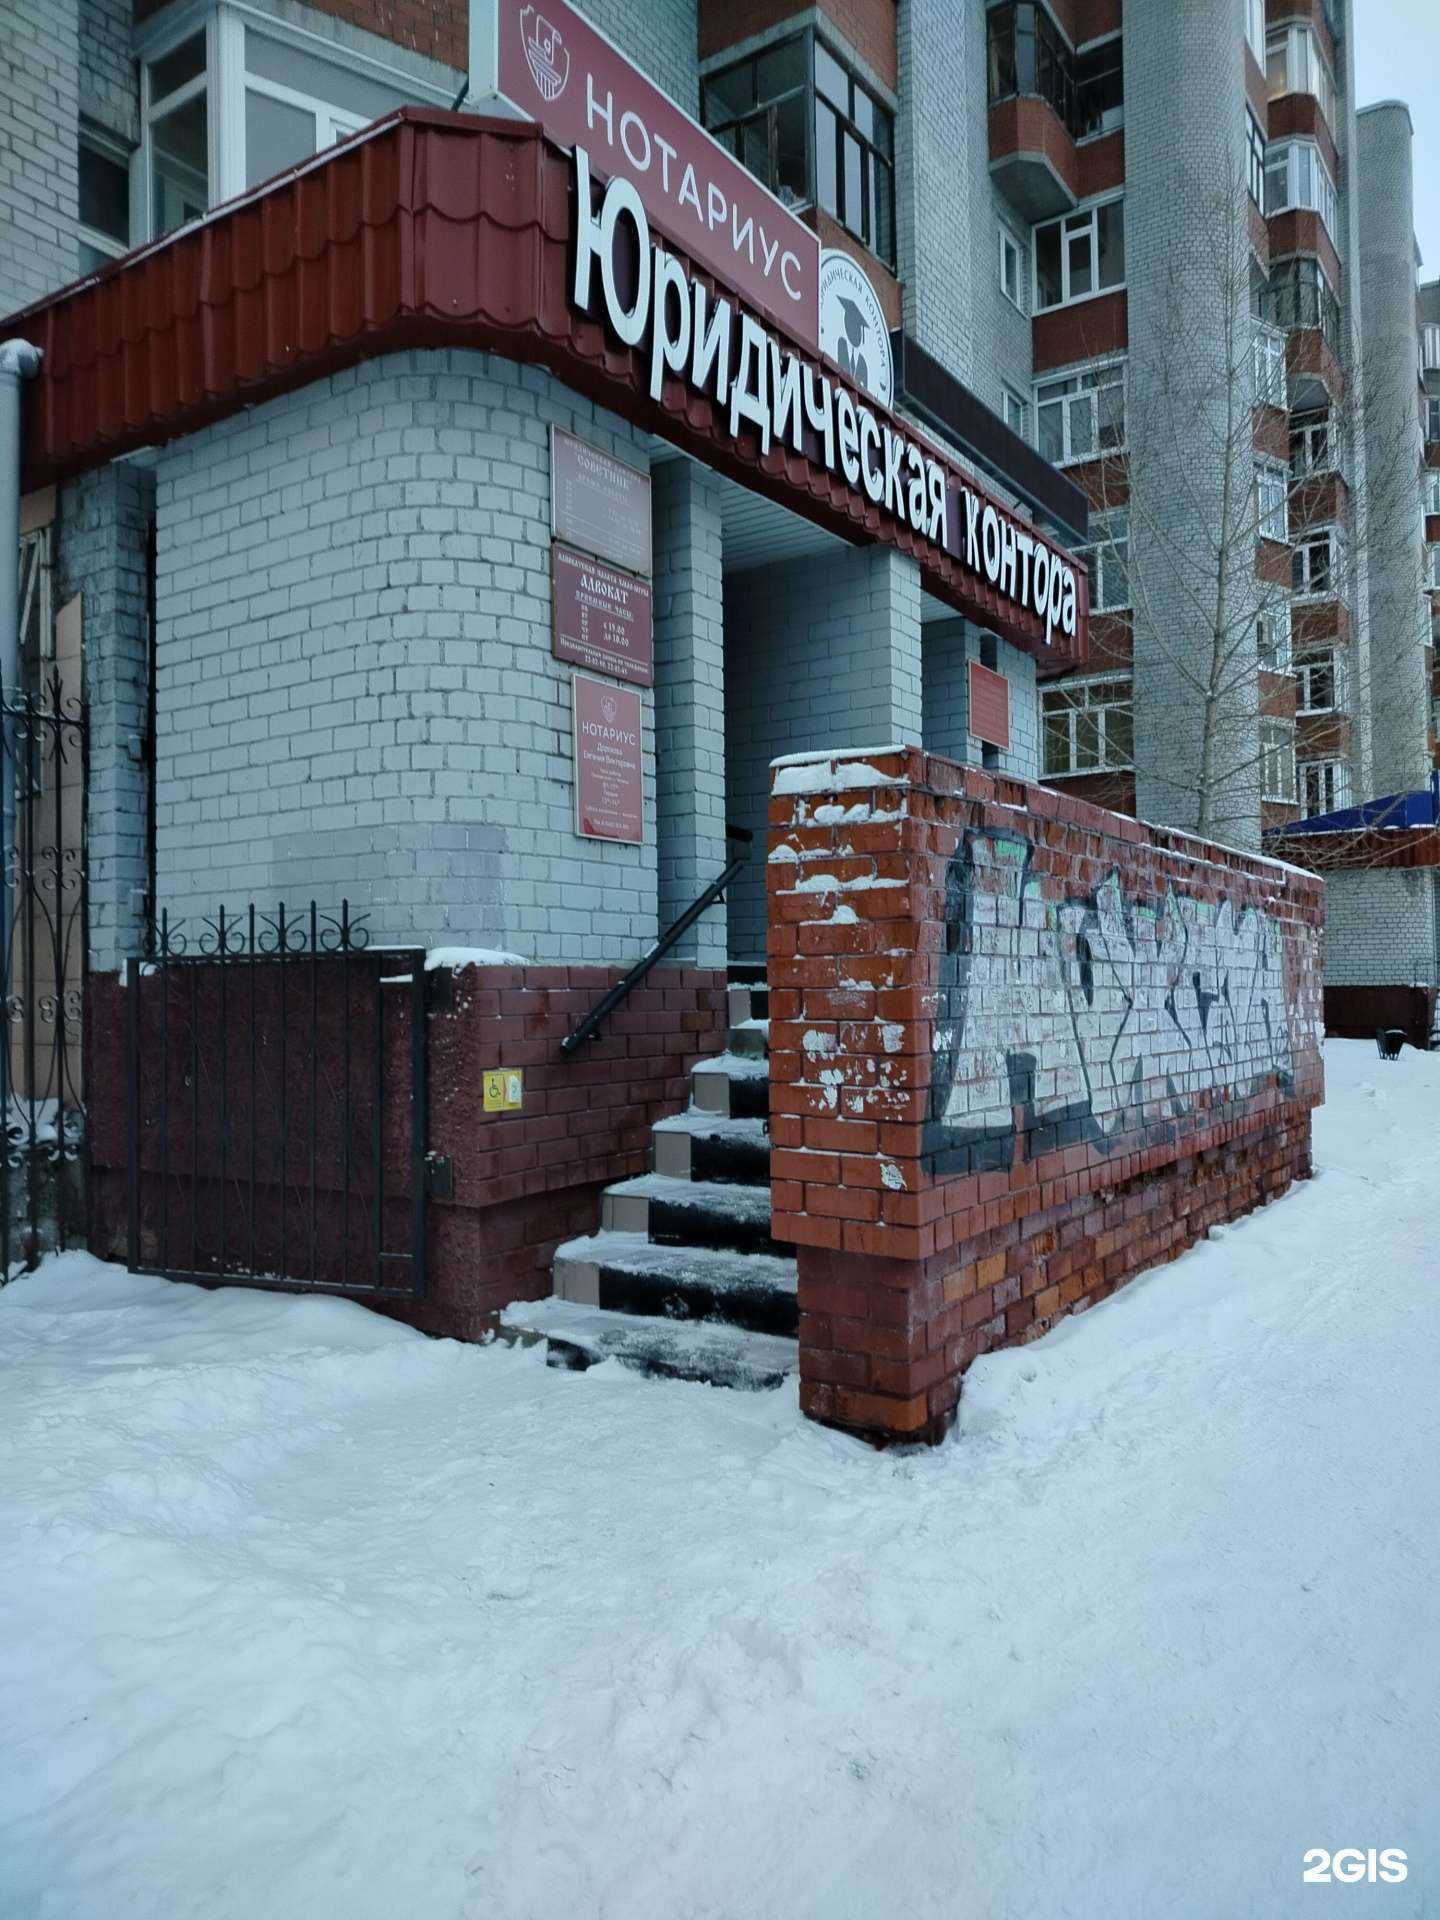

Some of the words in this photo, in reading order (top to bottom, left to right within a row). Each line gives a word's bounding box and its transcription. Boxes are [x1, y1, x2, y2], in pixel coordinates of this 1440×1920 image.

[586, 72, 802, 301] НОТАРИУС
[820, 268, 863, 309] РИДИЧЕСКАЯ
[573, 145, 948, 549] Юридическая
[961, 486, 1077, 645] контора
[580, 572, 628, 605] АДВОКАТ
[582, 721, 636, 746] НОТАРИУС
